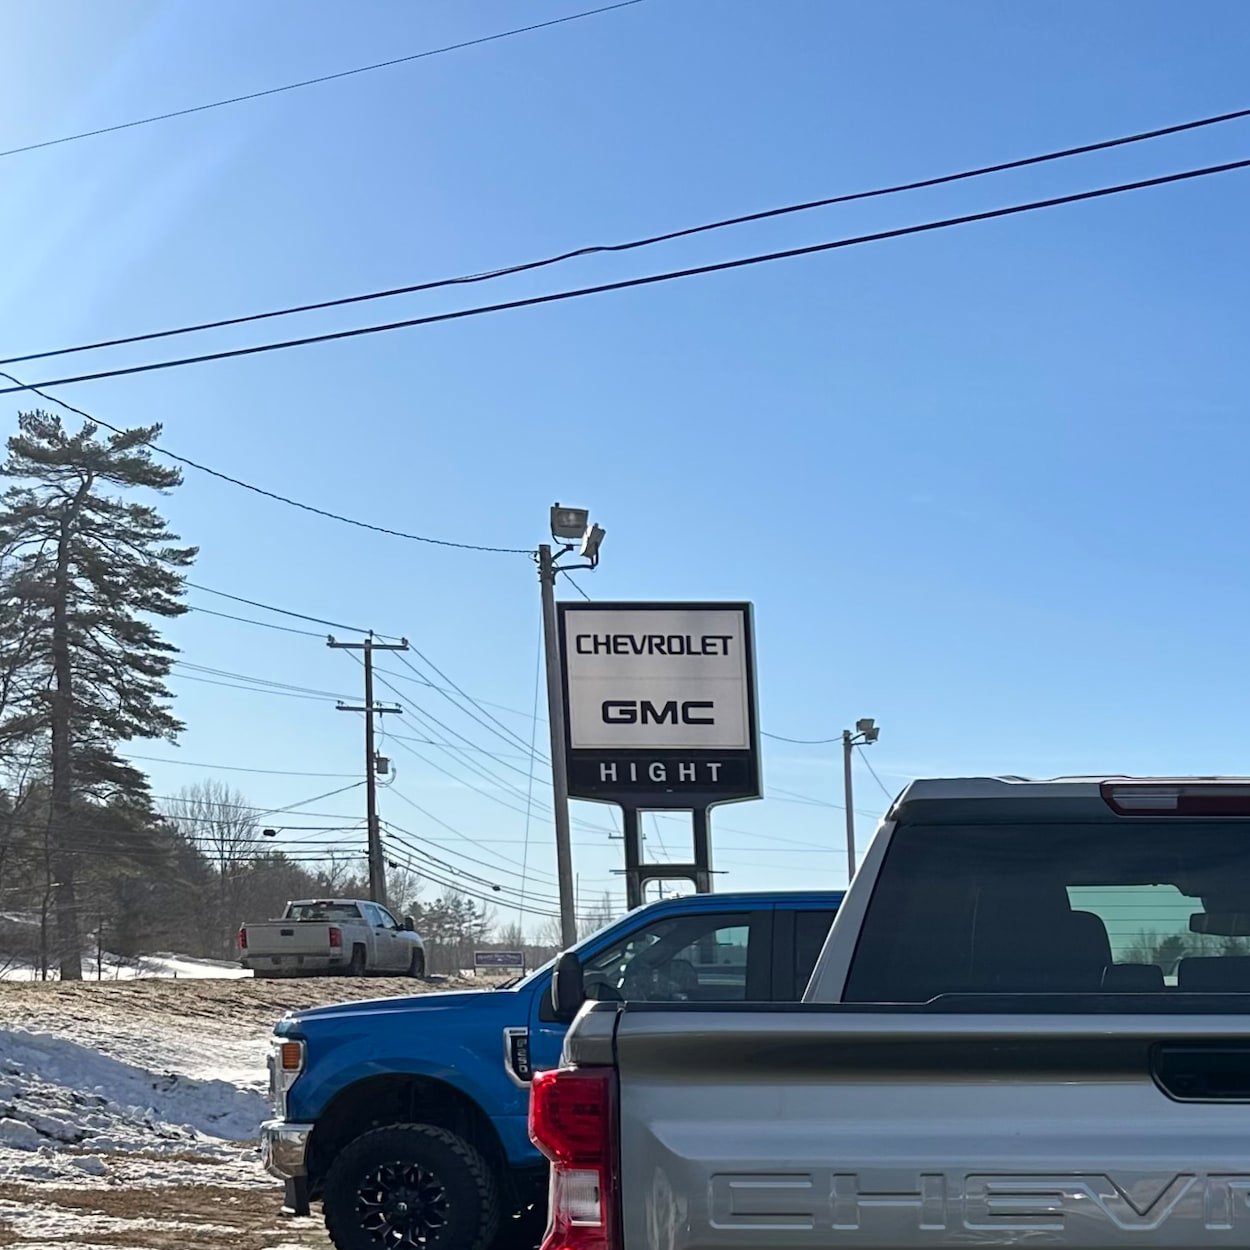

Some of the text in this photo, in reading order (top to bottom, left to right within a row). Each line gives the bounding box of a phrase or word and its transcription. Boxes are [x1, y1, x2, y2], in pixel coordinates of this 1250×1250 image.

[576, 634, 733, 656] CHEVROLET
[601, 700, 715, 725] GMC
[600, 762, 722, 782] HIGHT
